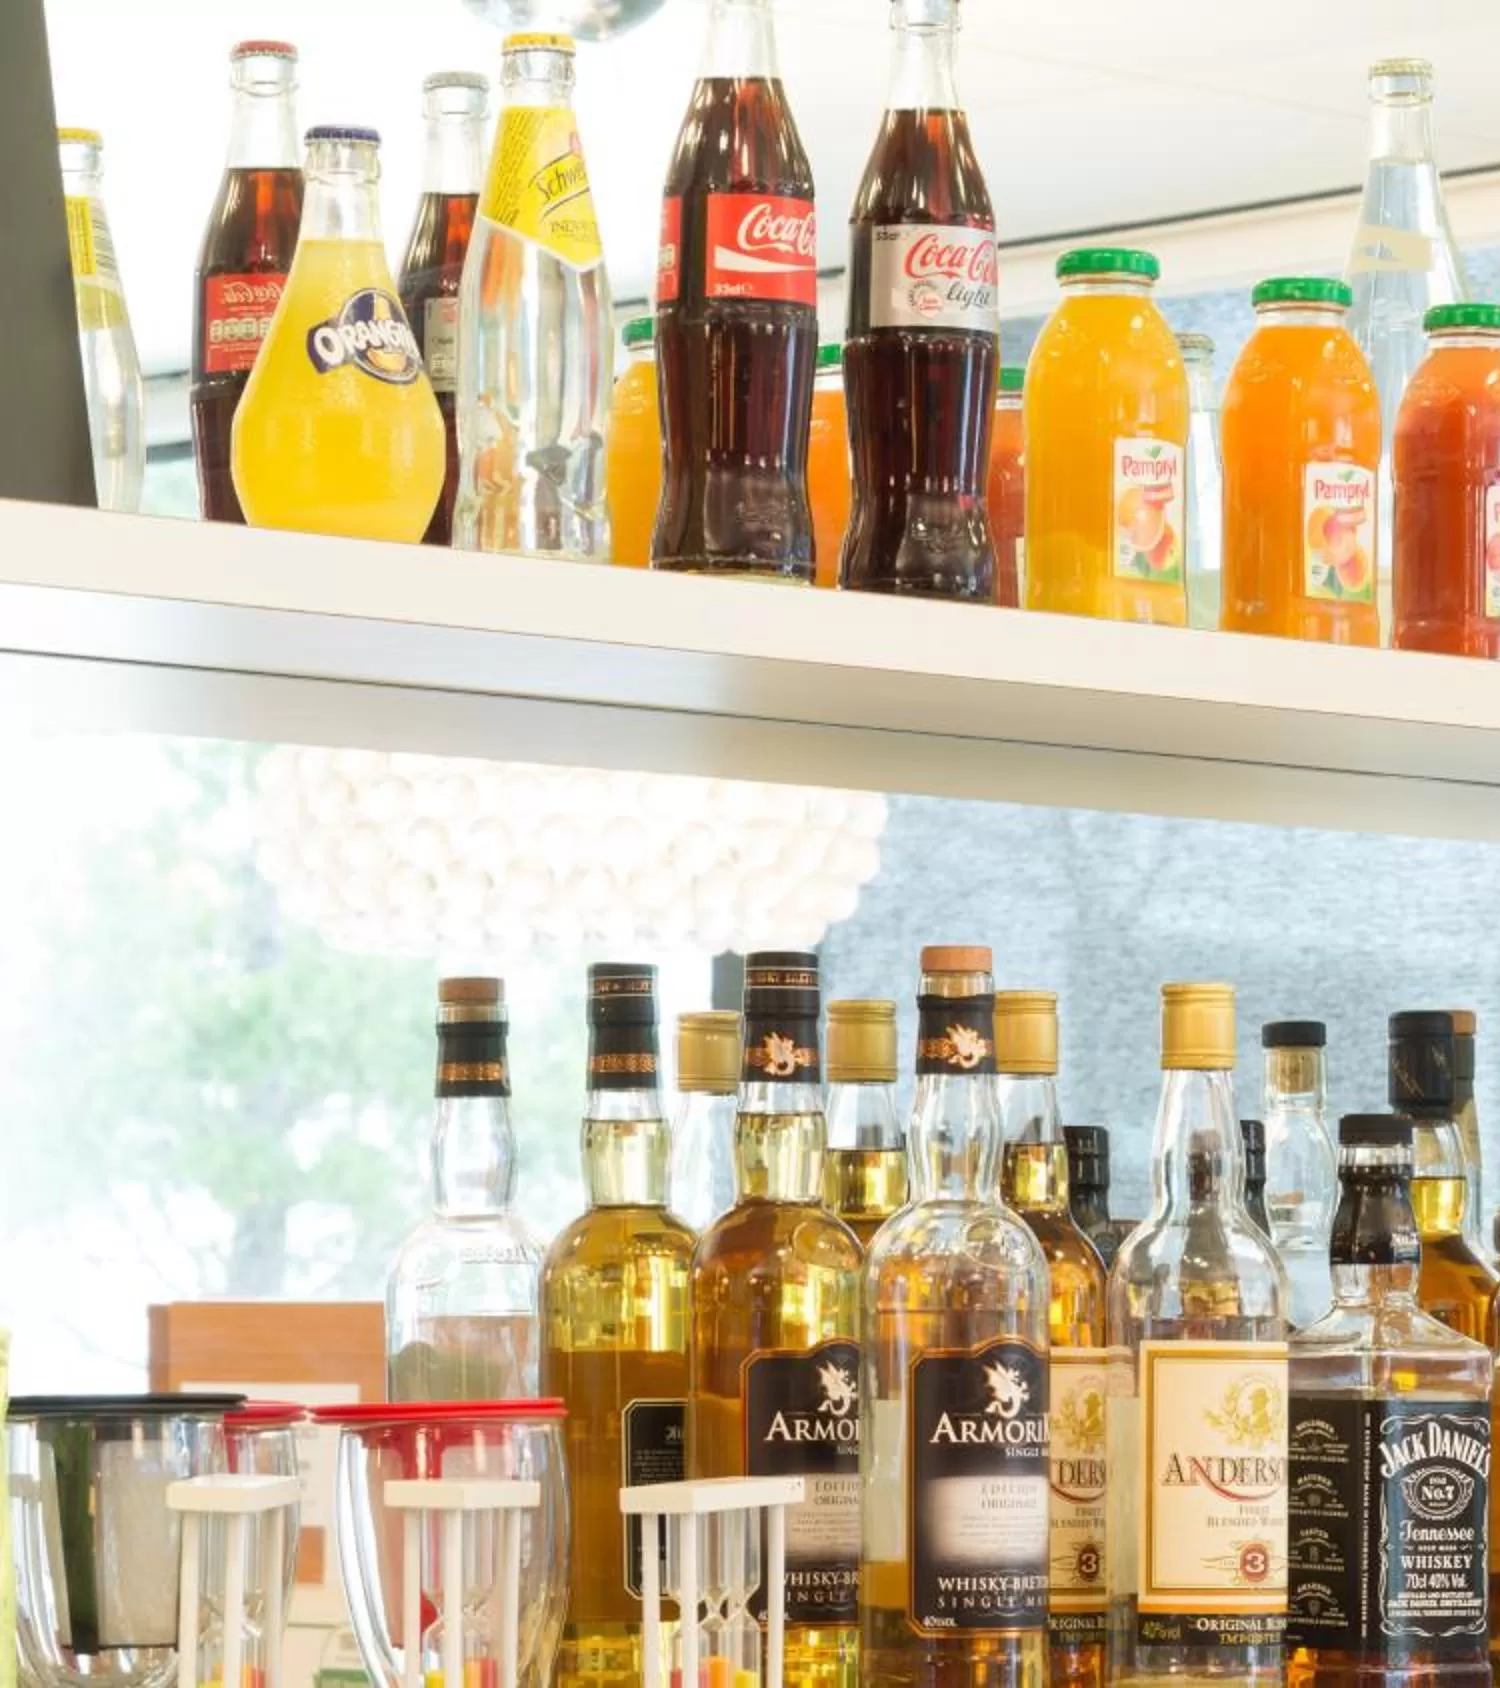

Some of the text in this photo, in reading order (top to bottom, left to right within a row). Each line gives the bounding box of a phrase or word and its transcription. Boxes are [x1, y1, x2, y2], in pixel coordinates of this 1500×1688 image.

[1379, 1432, 1428, 1478] JACK
[1400, 1520, 1475, 1540] Tennessee
[1081, 1554, 1097, 1573] 3
[1244, 1554, 1265, 1573] 3
[1399, 1555, 1473, 1569] WHISKEY
[788, 1591, 849, 1602] INGLE
